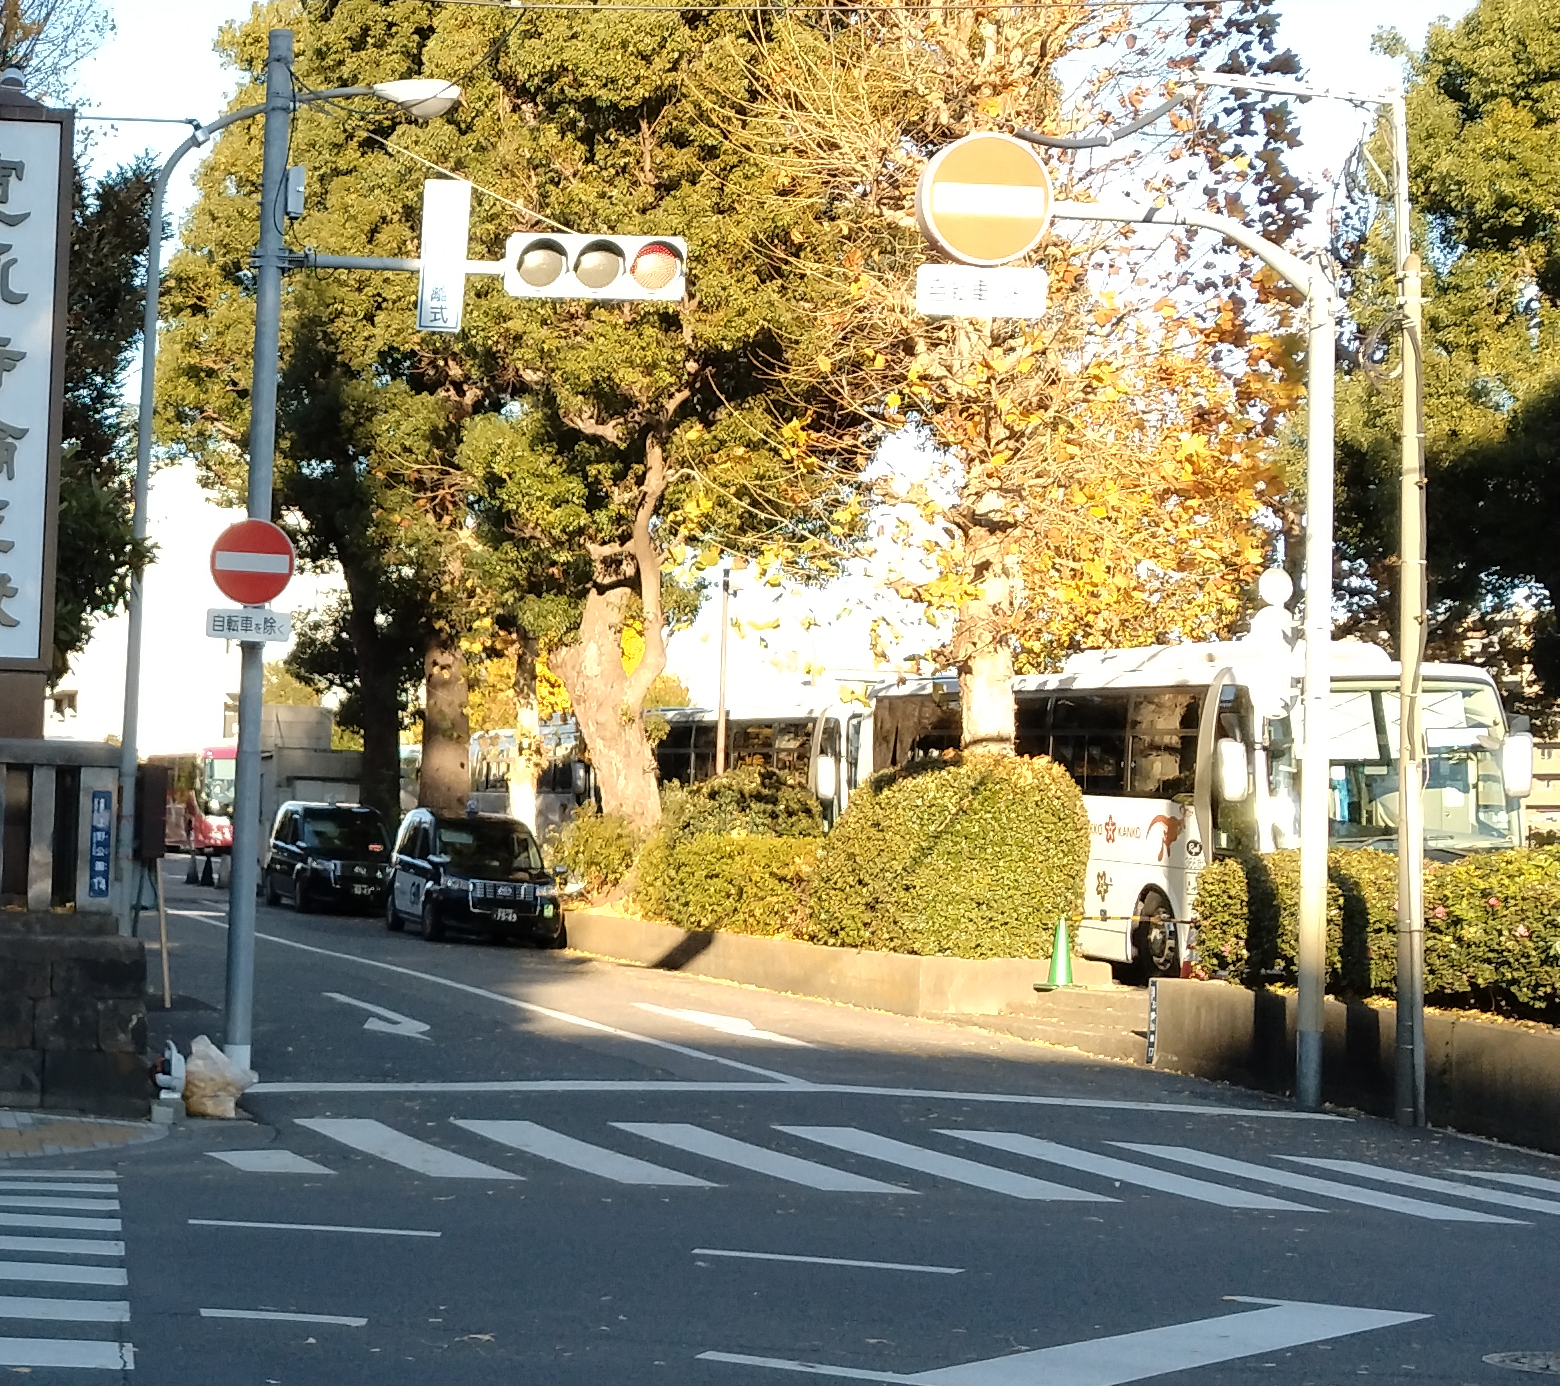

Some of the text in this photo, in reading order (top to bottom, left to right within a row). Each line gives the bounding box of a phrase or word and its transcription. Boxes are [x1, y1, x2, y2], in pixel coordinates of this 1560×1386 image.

[212, 614, 285, 636] 自転車を除く
